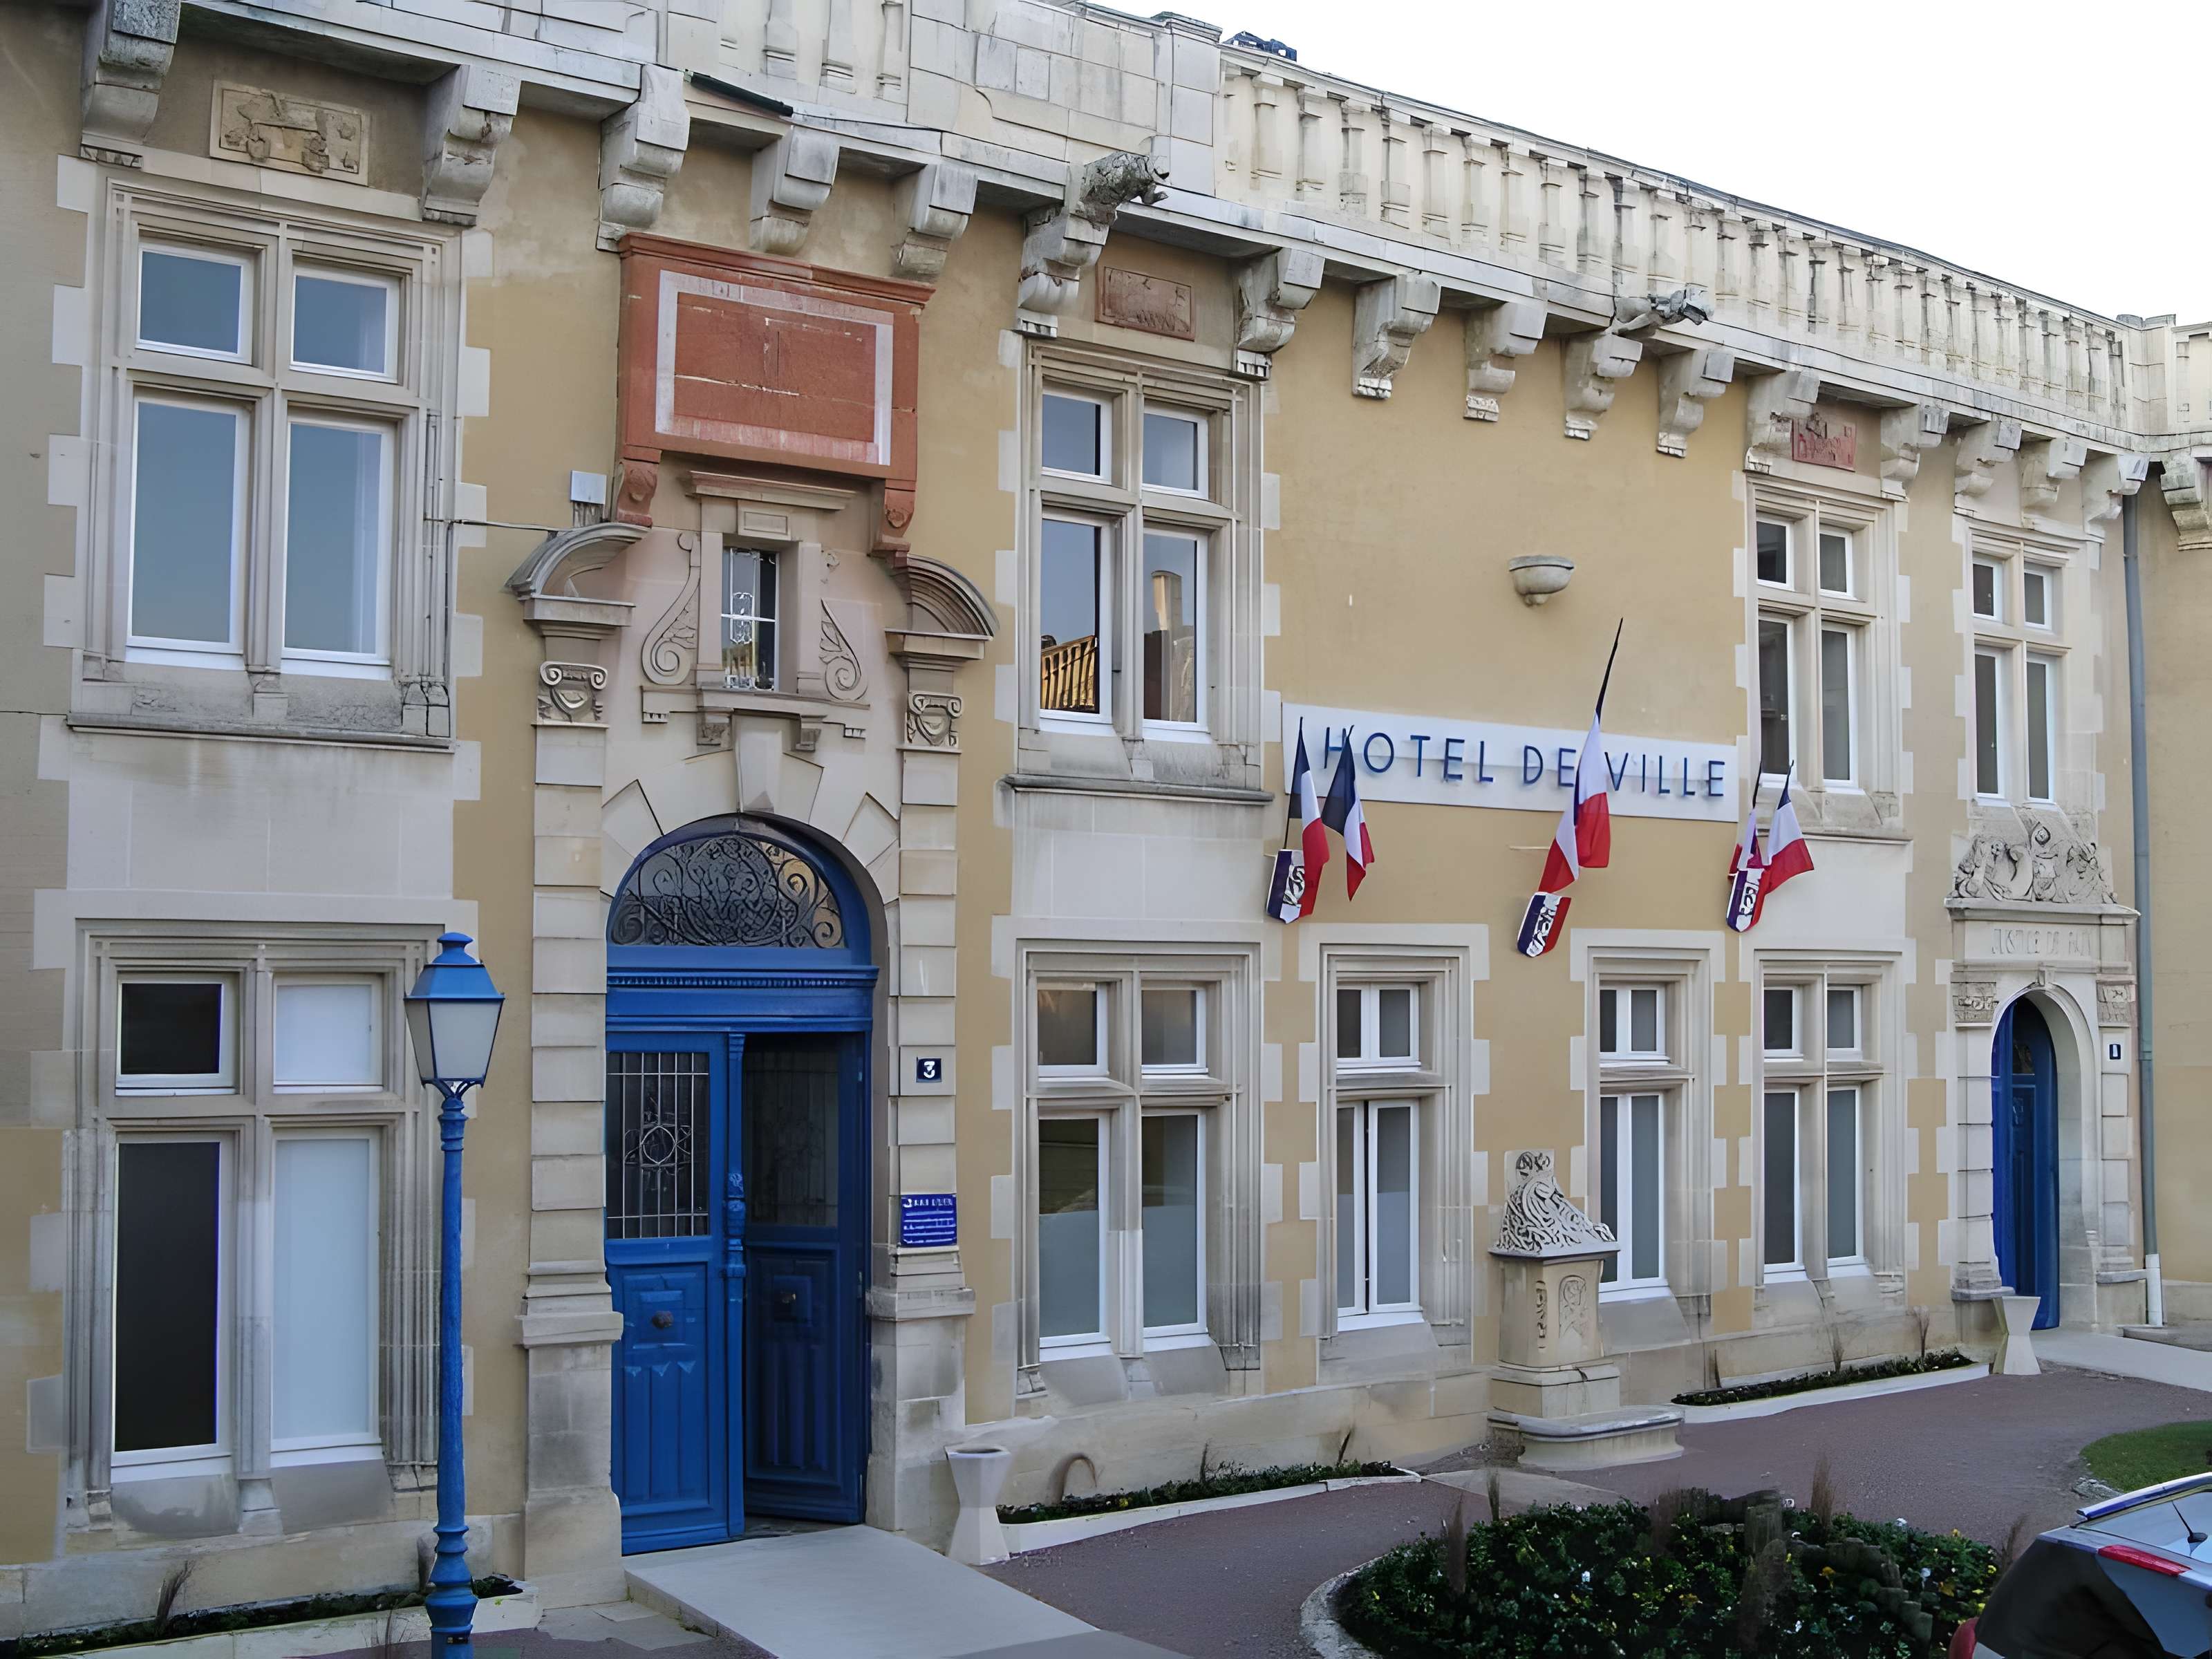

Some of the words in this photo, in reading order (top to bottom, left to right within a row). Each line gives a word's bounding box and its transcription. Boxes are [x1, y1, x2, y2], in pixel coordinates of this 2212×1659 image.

[1324, 727, 1494, 782] HOTEL
[1523, 745, 1577, 787] DE
[1604, 751, 1725, 797] VILLE
[924, 1061, 935, 1078] 3
